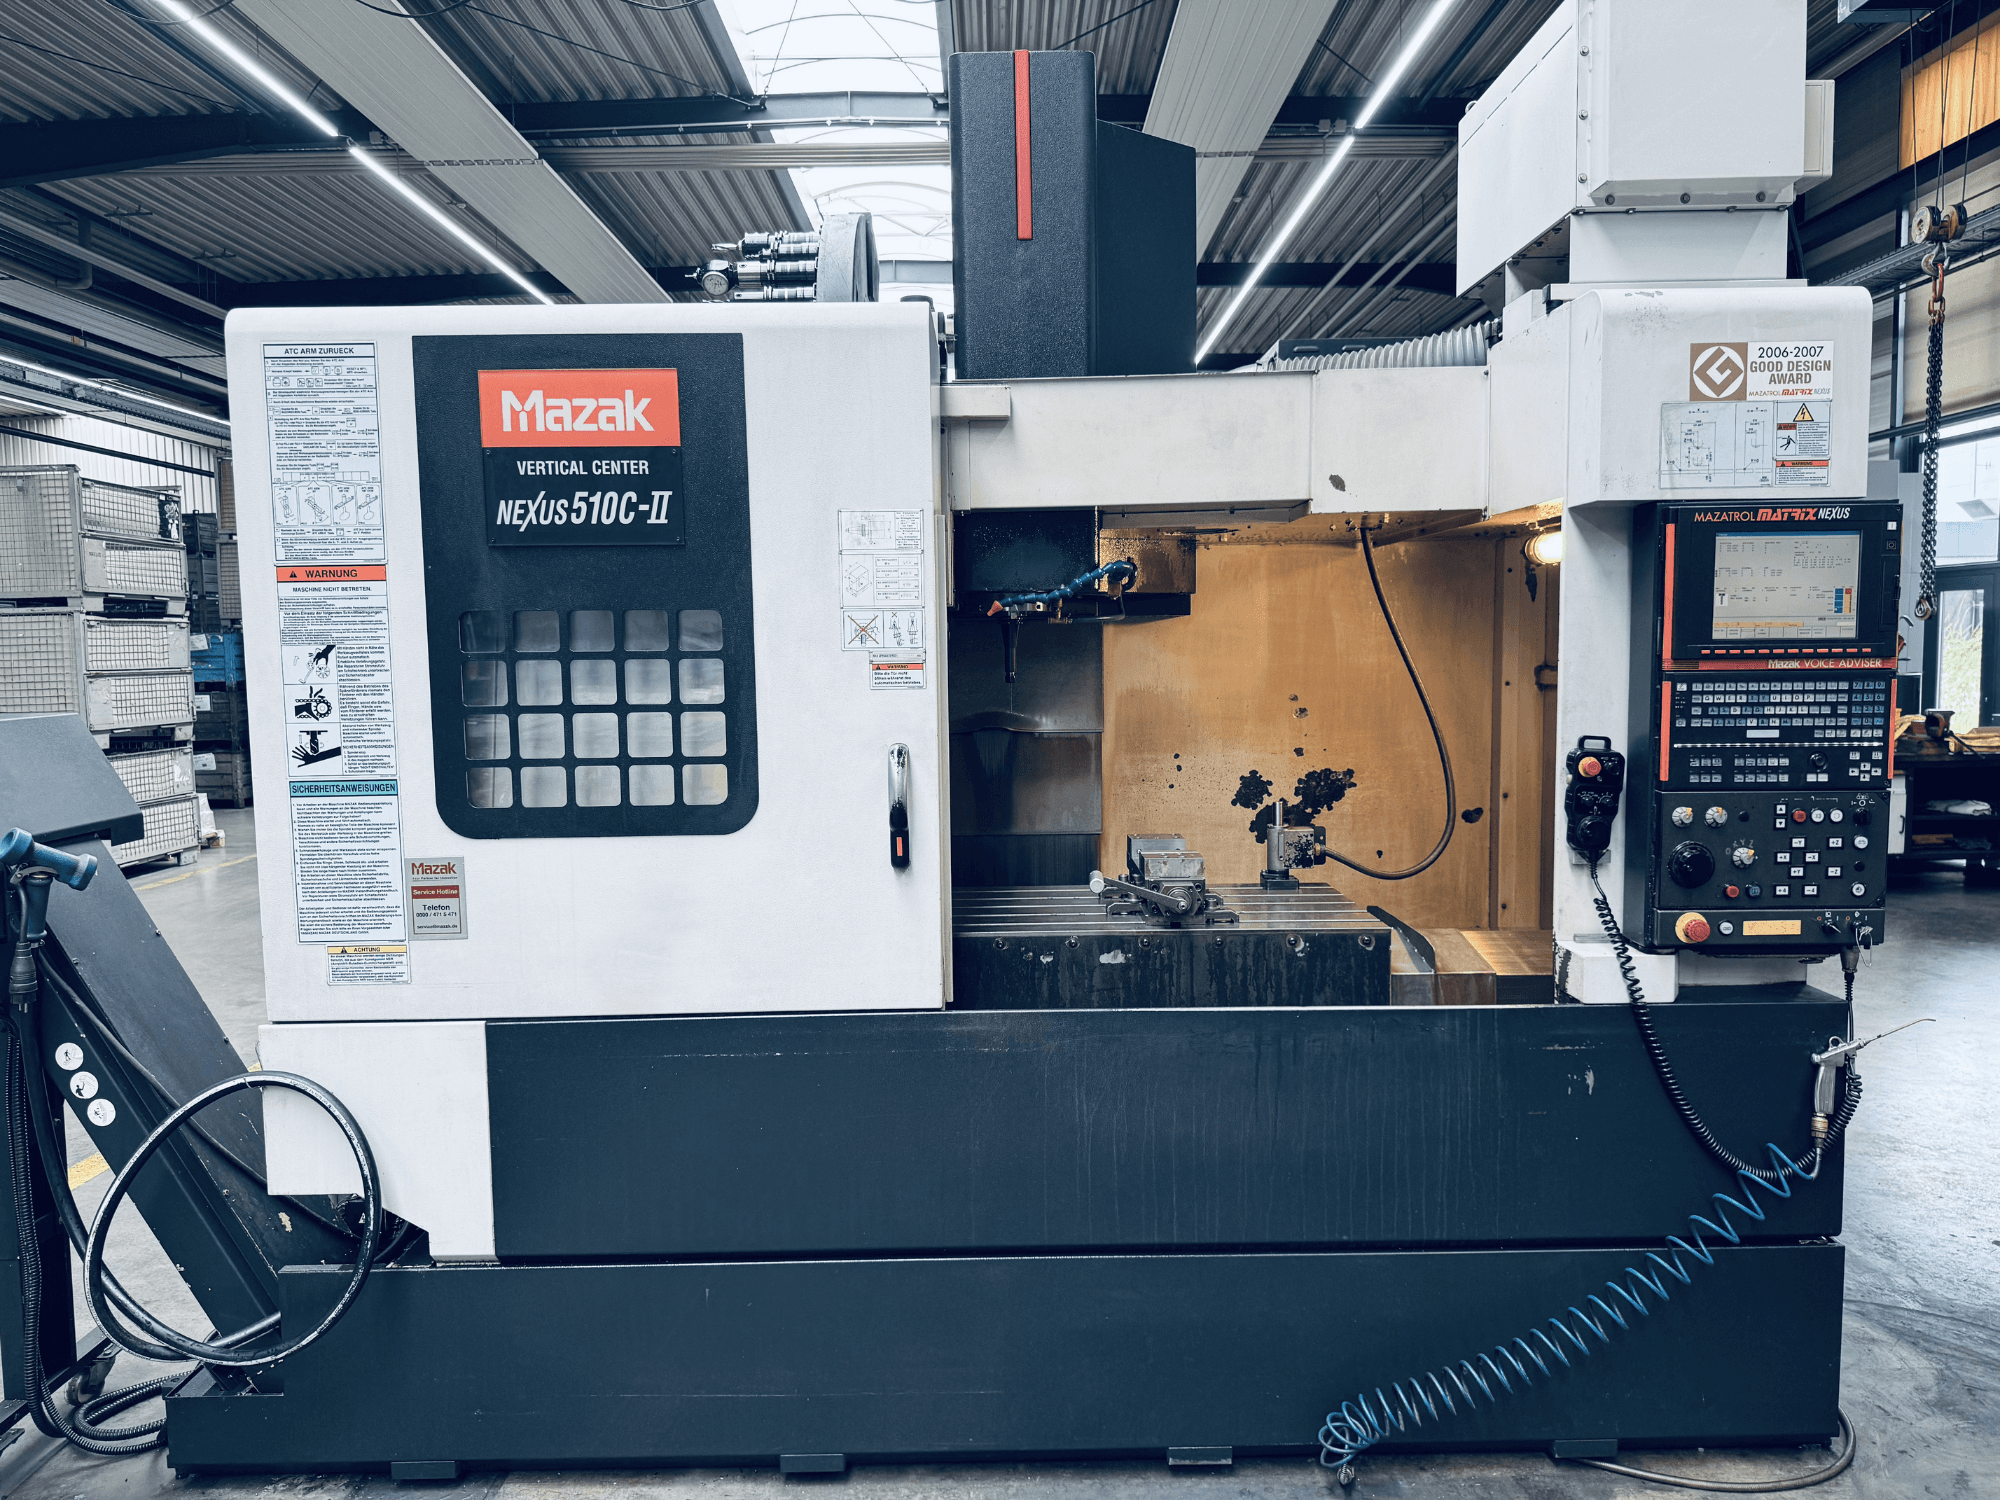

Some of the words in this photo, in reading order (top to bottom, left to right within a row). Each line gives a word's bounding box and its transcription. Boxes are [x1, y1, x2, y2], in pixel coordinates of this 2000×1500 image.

[1758, 346, 1824, 358] 2006-2007
[1750, 360, 1783, 373] GOOD
[1787, 359, 1831, 372] DESIGN
[1769, 373, 1812, 385] AWARD
[501, 390, 655, 432] Mazak
[517, 460, 588, 475] VERTICAL
[592, 460, 649, 475] CENTER
[1694, 511, 1755, 522] MAZATROL
[1756, 508, 1818, 521] MATRIX
[1818, 506, 1850, 520] NEXUS
[305, 570, 358, 578] WARNUNG
[1768, 659, 1800, 668] Mazak
[1804, 658, 1835, 668] VOICE
[1839, 658, 1882, 668] ADVISER
[292, 784, 396, 793] SICHERHEITSANWEISUNGEN
[1749, 839, 1754, 848] Z
[412, 862, 457, 875] Mazak
